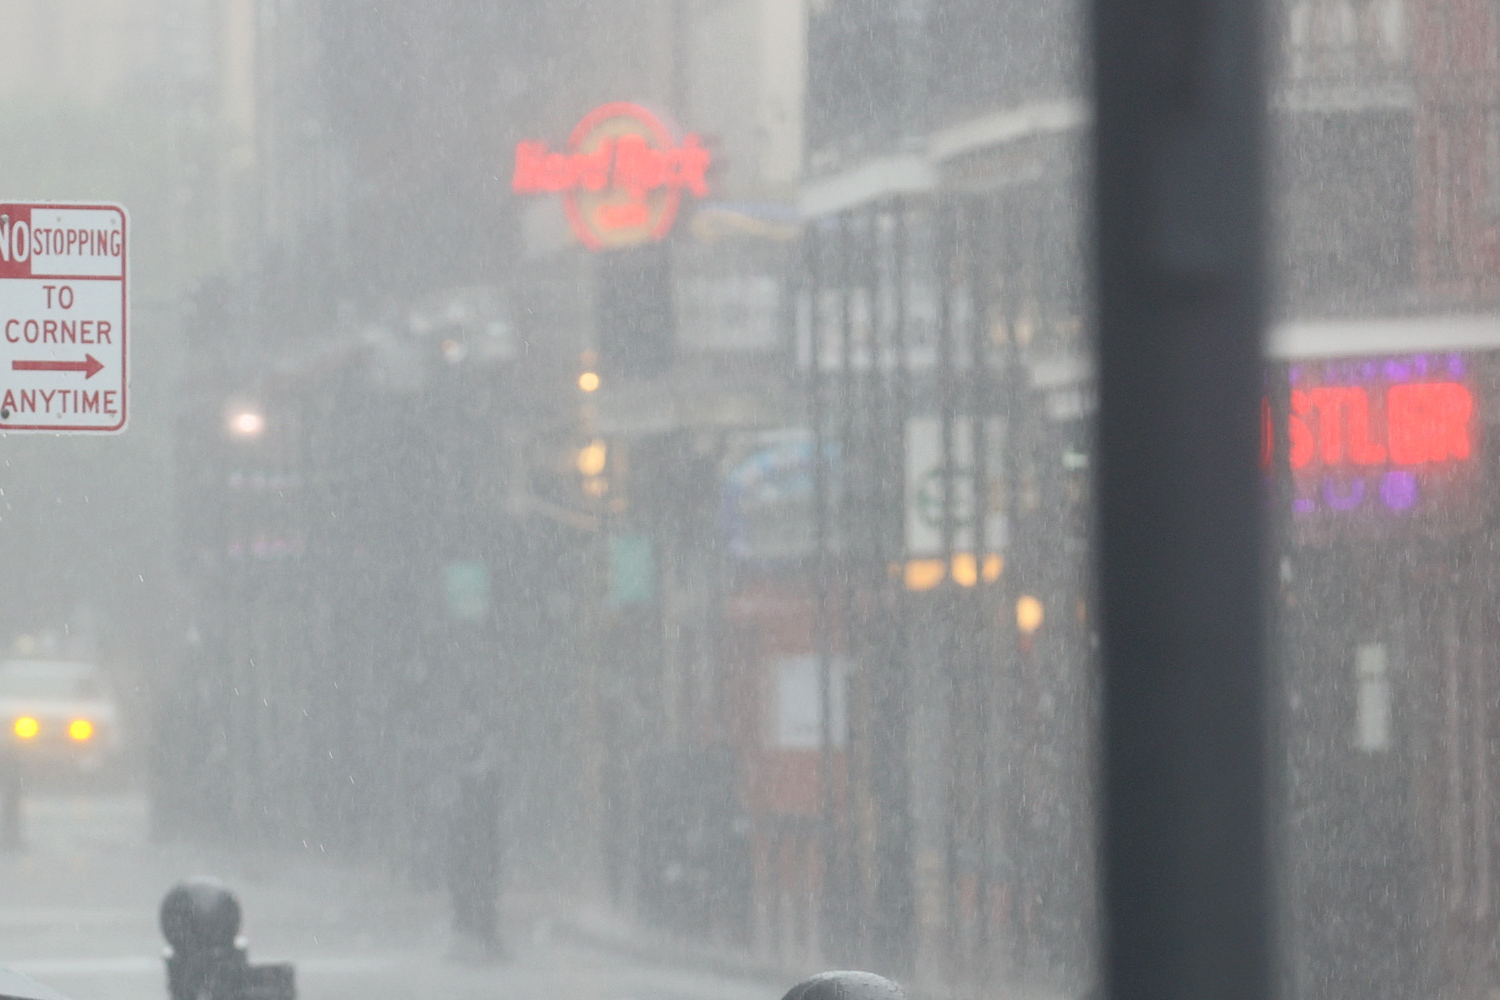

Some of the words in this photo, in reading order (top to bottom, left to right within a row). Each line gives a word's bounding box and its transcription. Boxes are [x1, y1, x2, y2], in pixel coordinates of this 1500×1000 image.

[32, 228, 122, 257] STOPPING
[41, 285, 75, 310] TO
[4, 319, 113, 345] CORNER
[1, 388, 118, 414] ANYTIME
